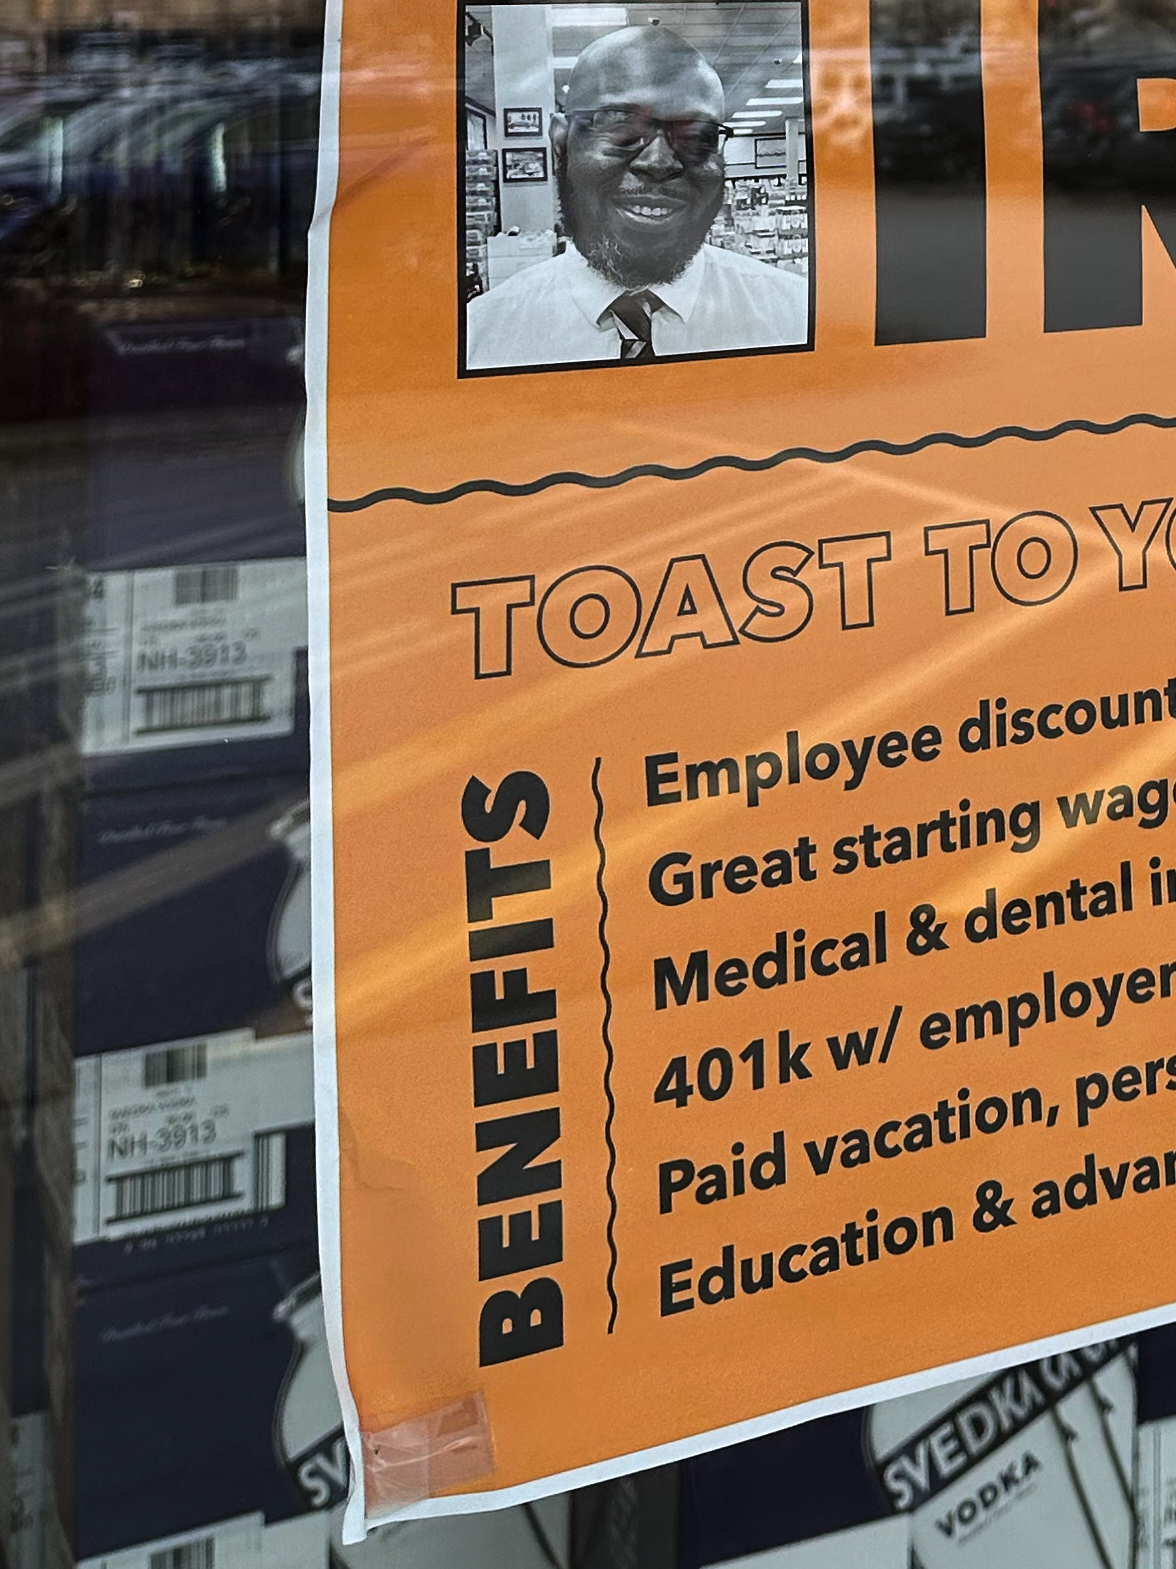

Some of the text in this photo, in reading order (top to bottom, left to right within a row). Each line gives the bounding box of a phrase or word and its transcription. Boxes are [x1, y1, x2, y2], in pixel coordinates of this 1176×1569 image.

[451, 531, 891, 680] TOAST
[924, 510, 1078, 615] TO
[644, 724, 943, 807] Employee
[648, 836, 817, 906] Great
[832, 799, 1042, 875] starting
[653, 912, 887, 1011] Medical
[905, 904, 949, 957] &
[964, 862, 1133, 944] dental
[461, 770, 564, 1368] BENEFITS
[653, 1030, 813, 1109] 401k
[826, 1005, 903, 1071] w/
[107, 1119, 217, 1163] NH-3913
[658, 1131, 787, 1214] Paid
[803, 1087, 1060, 1176] vacation,
[659, 1204, 954, 1317] Education
[972, 1179, 1017, 1233] &
[883, 1368, 1045, 1510] SVEDKA
[935, 1449, 1041, 1539] VODKA
